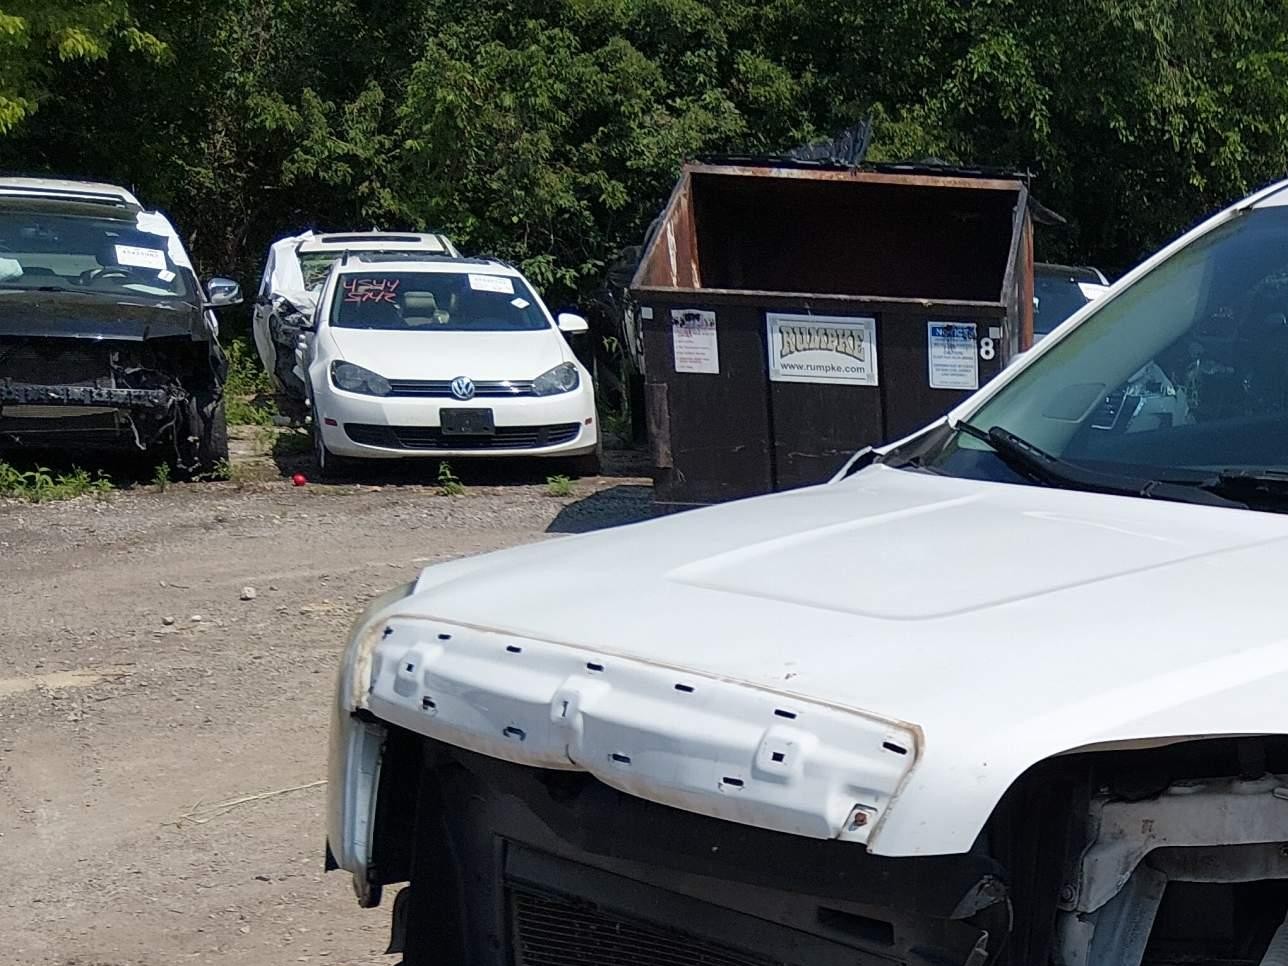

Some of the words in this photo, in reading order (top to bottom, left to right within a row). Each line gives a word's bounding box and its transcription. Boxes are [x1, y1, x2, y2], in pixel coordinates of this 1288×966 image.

[779, 326, 865, 362] RUMPKE
[980, 337, 995, 360] 8
[780, 363, 865, 374] www.rumpke.com
